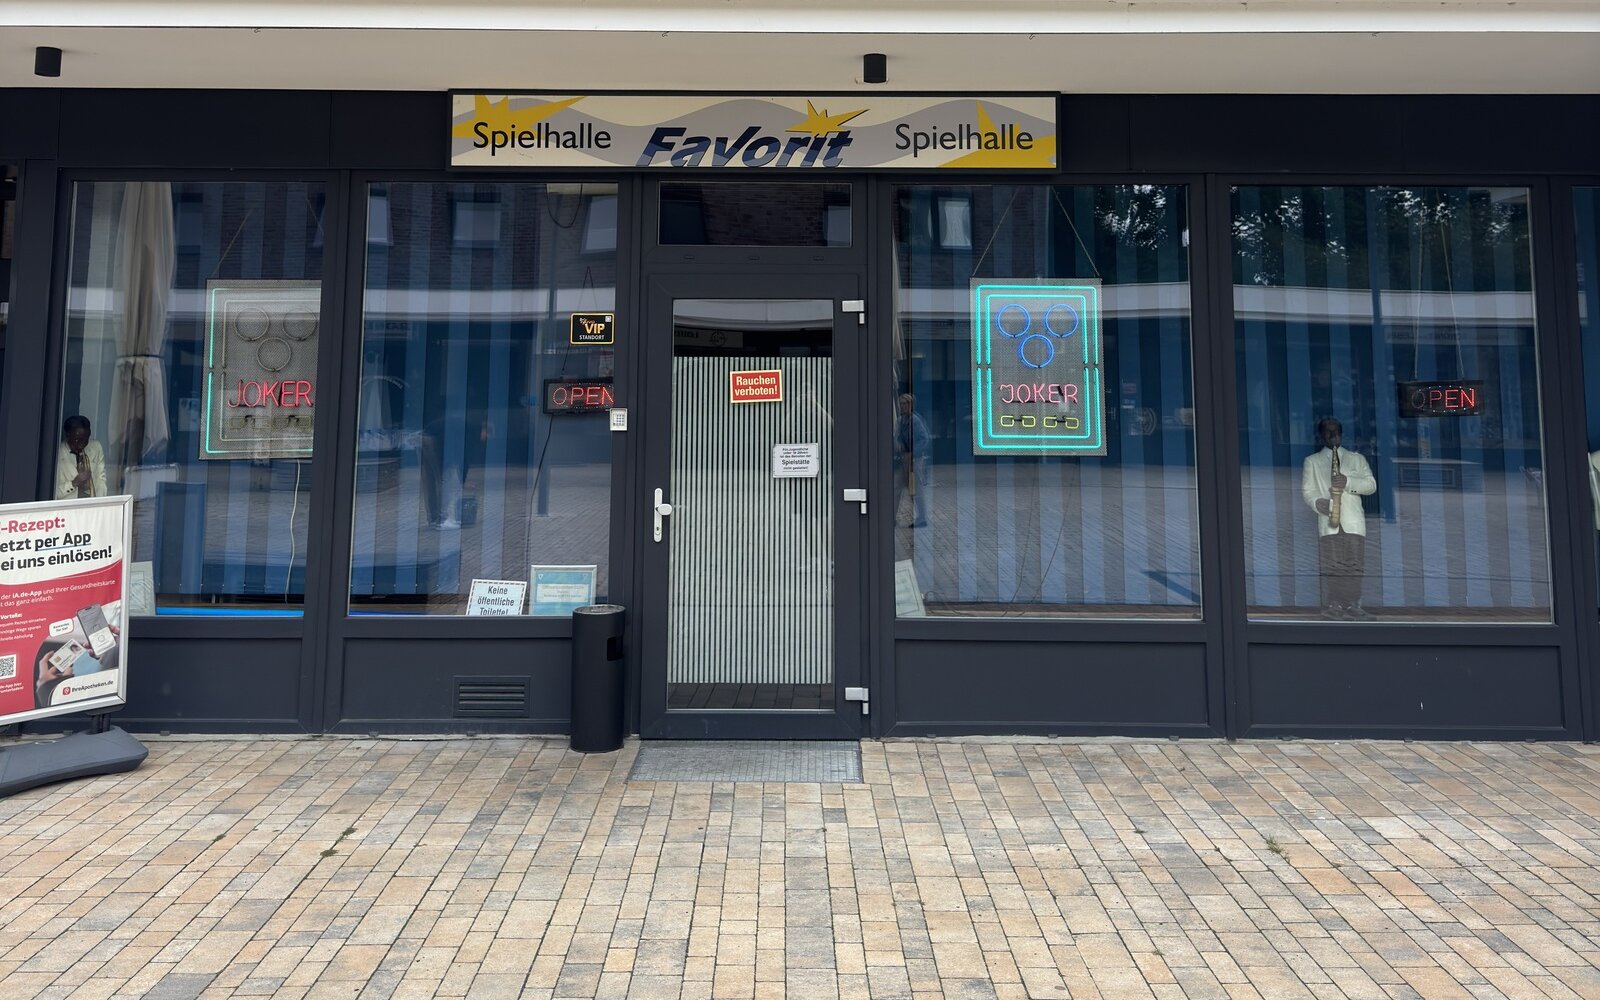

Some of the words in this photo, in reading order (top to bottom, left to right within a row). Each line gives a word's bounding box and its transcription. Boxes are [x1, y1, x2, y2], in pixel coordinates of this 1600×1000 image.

[473, 121, 612, 156] Spielhalle
[635, 125, 853, 168] Favorit
[895, 123, 1034, 158] Spielhalle
[585, 323, 606, 334] VIP
[734, 385, 778, 396] verboten!
[736, 375, 776, 386] Rauchen
[227, 380, 314, 408] JOKER
[552, 386, 614, 405] OPEN
[999, 383, 1078, 404] JOKER
[1411, 388, 1475, 409] OPEN
[0, 517, 66, 533] -Rezept:
[0, 538, 32, 553] etzt
[34, 536, 60, 552] per
[62, 532, 92, 546] App
[0, 557, 15, 571] ei
[17, 556, 45, 570] uns
[48, 545, 112, 565] einlösen!
[477, 596, 514, 606] öffentliche
[488, 586, 508, 595] Keine
